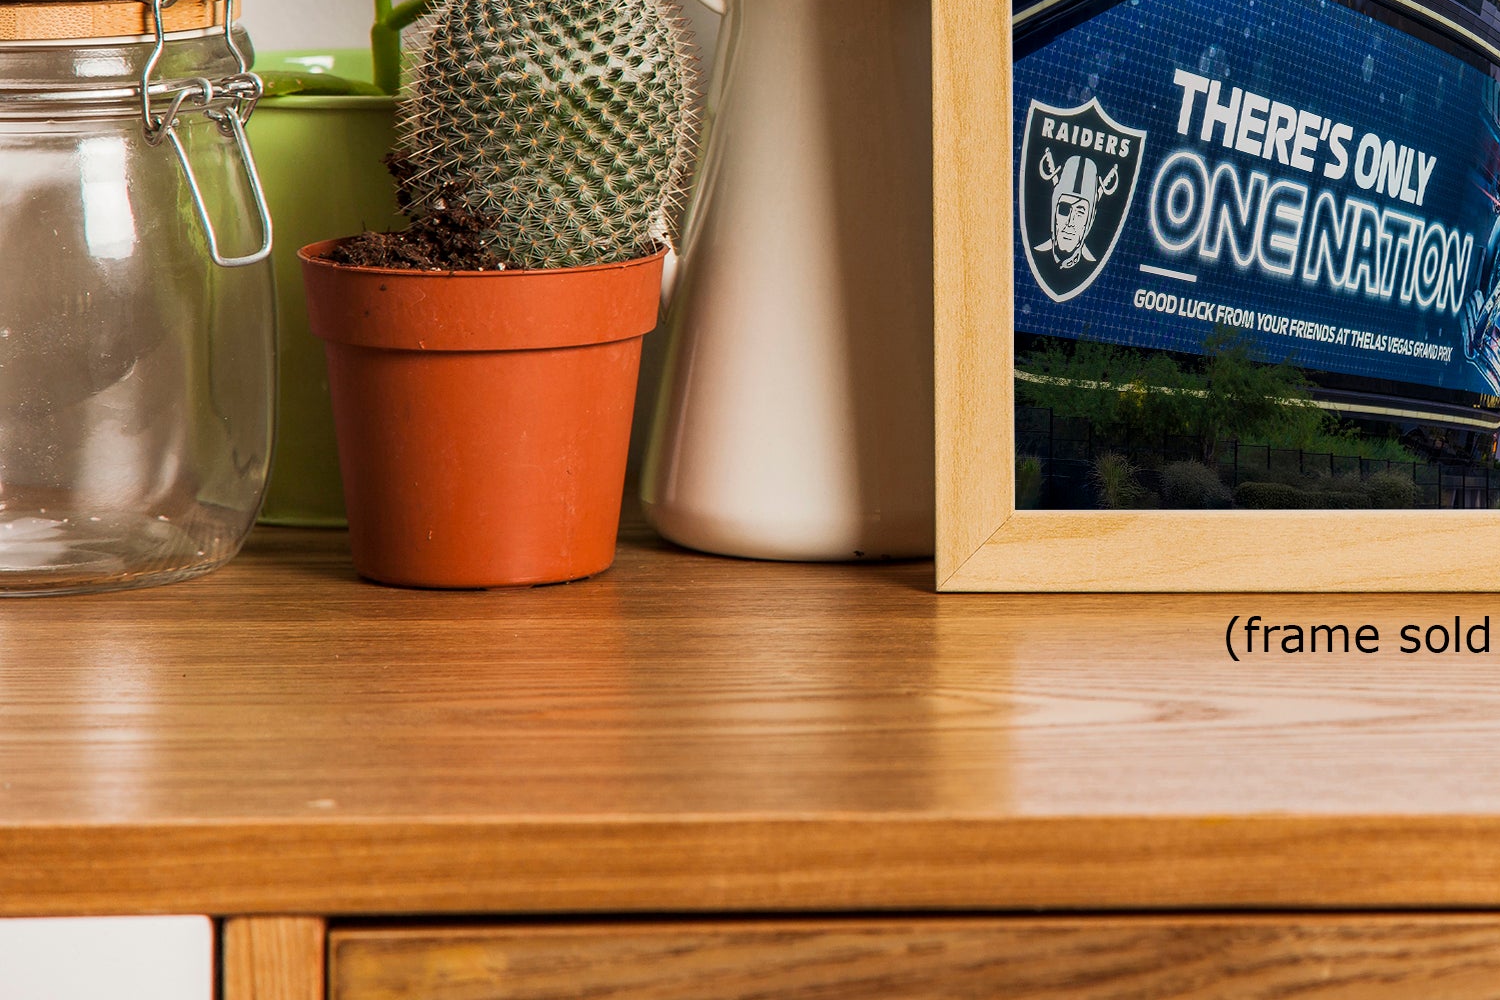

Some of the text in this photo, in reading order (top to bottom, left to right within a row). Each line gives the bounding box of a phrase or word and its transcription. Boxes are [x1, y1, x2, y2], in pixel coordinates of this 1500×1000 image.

[1041, 117, 1131, 158] RAIDERS
[1173, 68, 1437, 206] THERE'S ONLY
[1150, 151, 1474, 314] ONE NATION
[1134, 288, 1178, 314] GOOD
[1178, 297, 1216, 322] LUCK
[1215, 304, 1255, 329] FROM
[1257, 312, 1288, 335] YOUR
[1289, 318, 1337, 343] FRIENDS
[1334, 327, 1351, 345] AT
[1387, 335, 1414, 356] VEGAS
[1413, 341, 1438, 360] GRAND
[1436, 345, 1453, 362] PRIX
